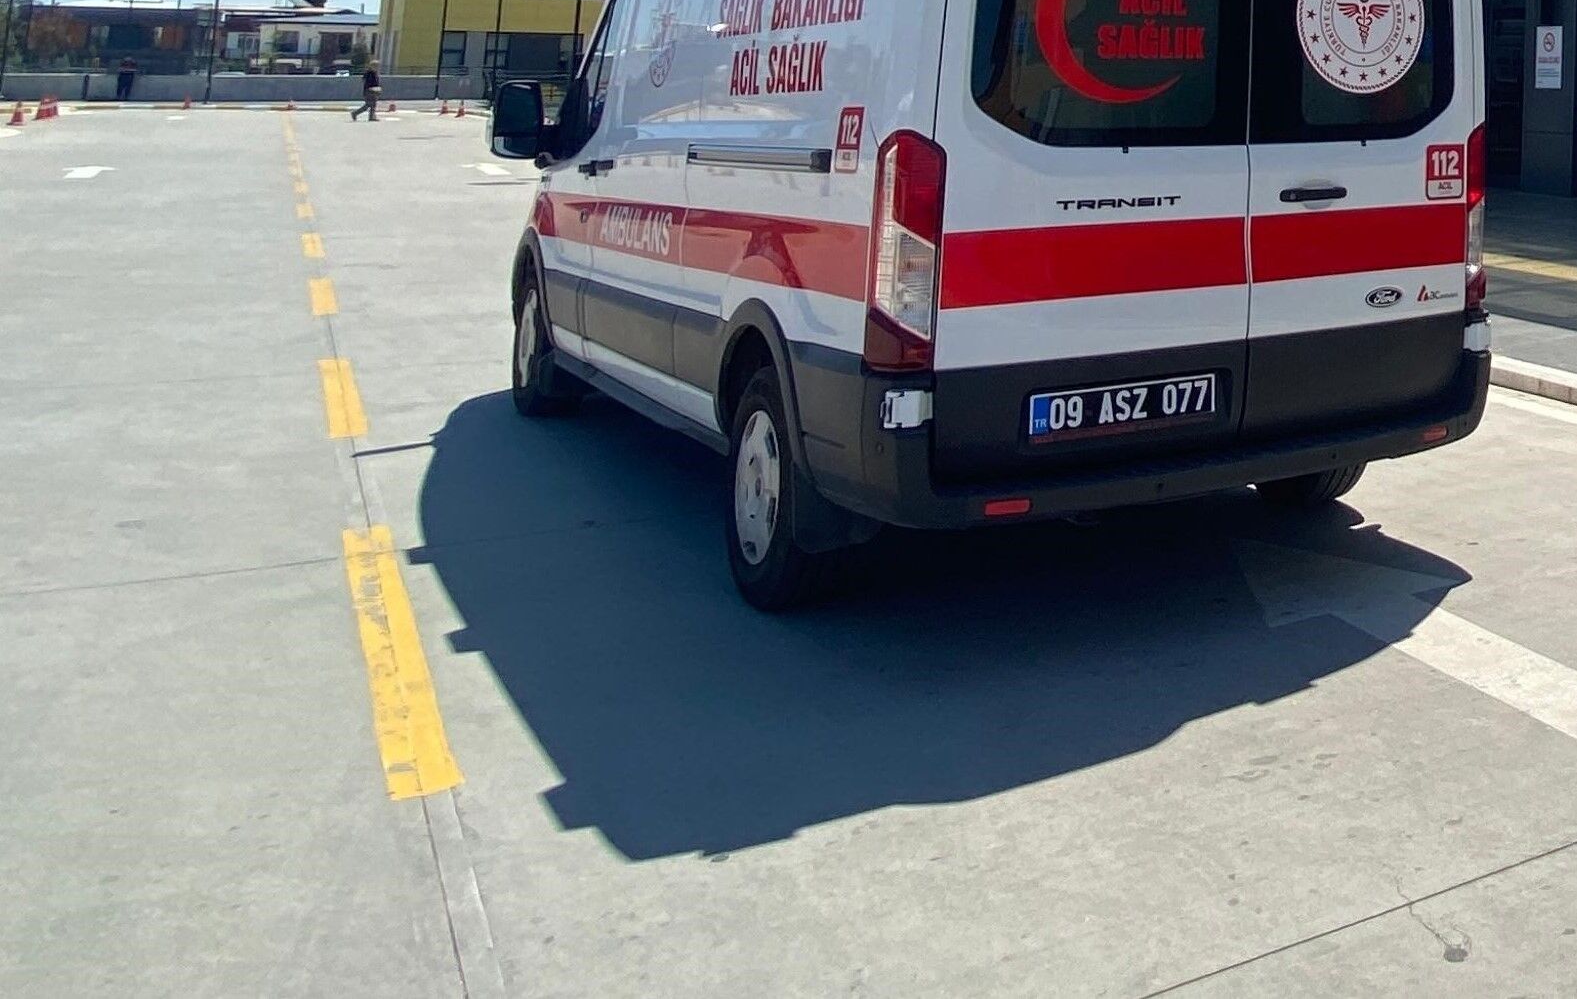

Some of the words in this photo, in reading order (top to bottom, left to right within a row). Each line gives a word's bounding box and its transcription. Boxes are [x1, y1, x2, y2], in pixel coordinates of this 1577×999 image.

[1097, 19, 1205, 59] SAĞLIK
[730, 40, 760, 96] ACİL
[766, 35, 828, 94] SAĞLIK
[841, 114, 860, 145] 112
[1431, 150, 1460, 176] 112
[1056, 195, 1182, 211] TRANSIT
[601, 205, 673, 257] AMBULANS
[1034, 418, 1047, 429] TR
[1049, 395, 1084, 430] 09
[1098, 387, 1148, 425] ASZ
[1162, 379, 1209, 415] 077
